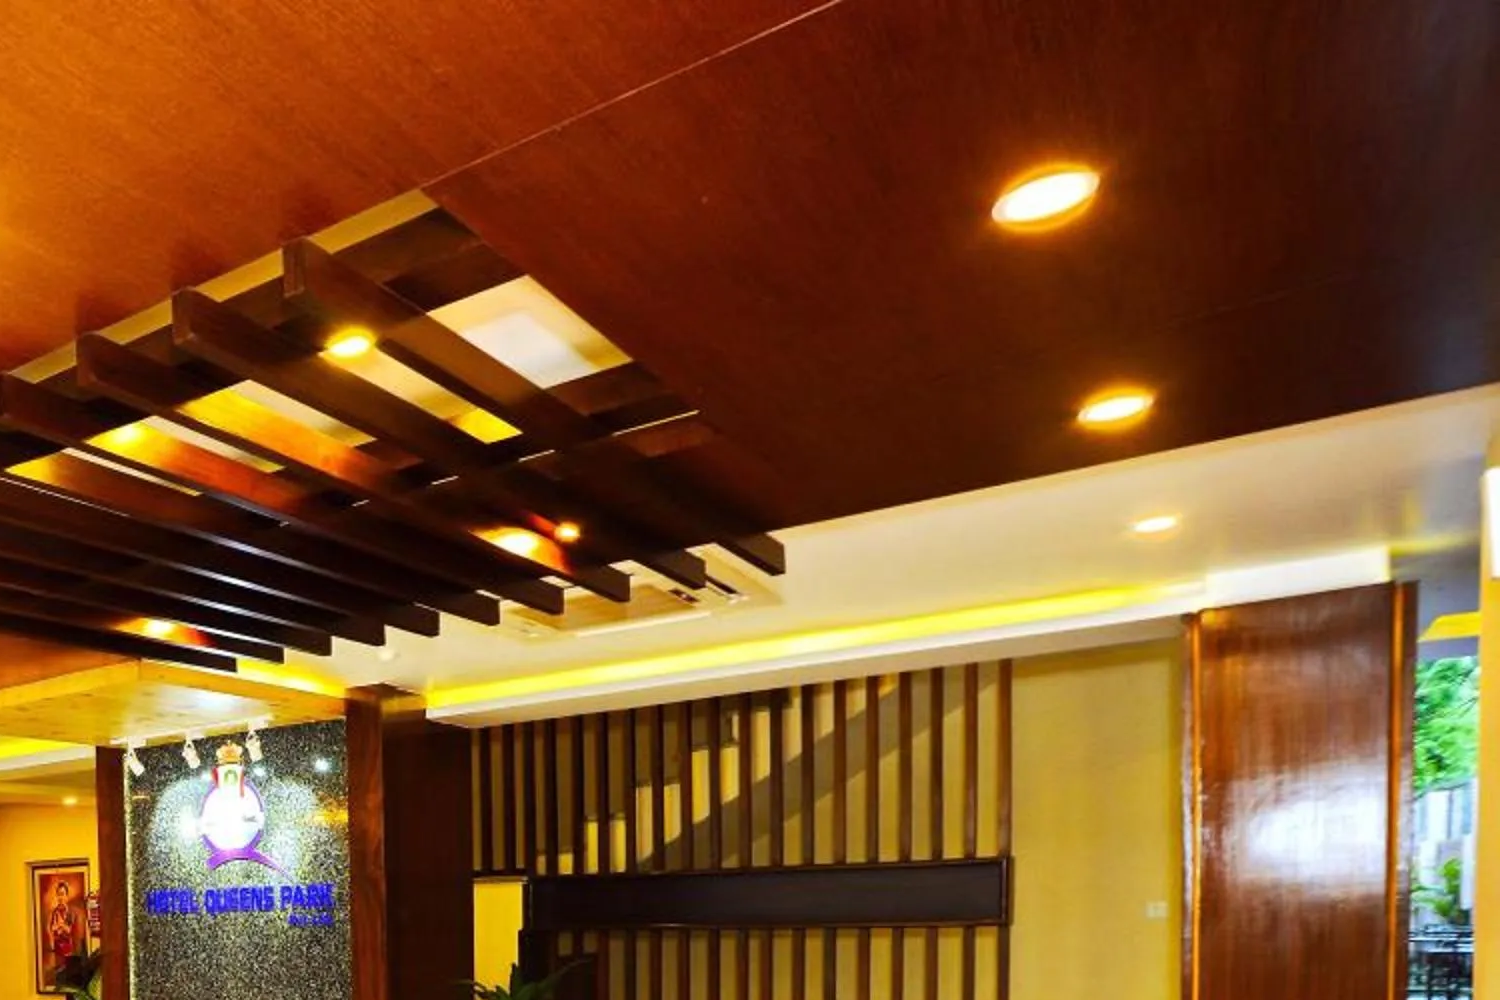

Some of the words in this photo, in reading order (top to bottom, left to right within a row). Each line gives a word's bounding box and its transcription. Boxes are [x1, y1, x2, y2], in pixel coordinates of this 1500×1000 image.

[147, 887, 199, 914] HOTEL
[204, 885, 275, 917] QUEENS
[280, 882, 335, 911] PARK
